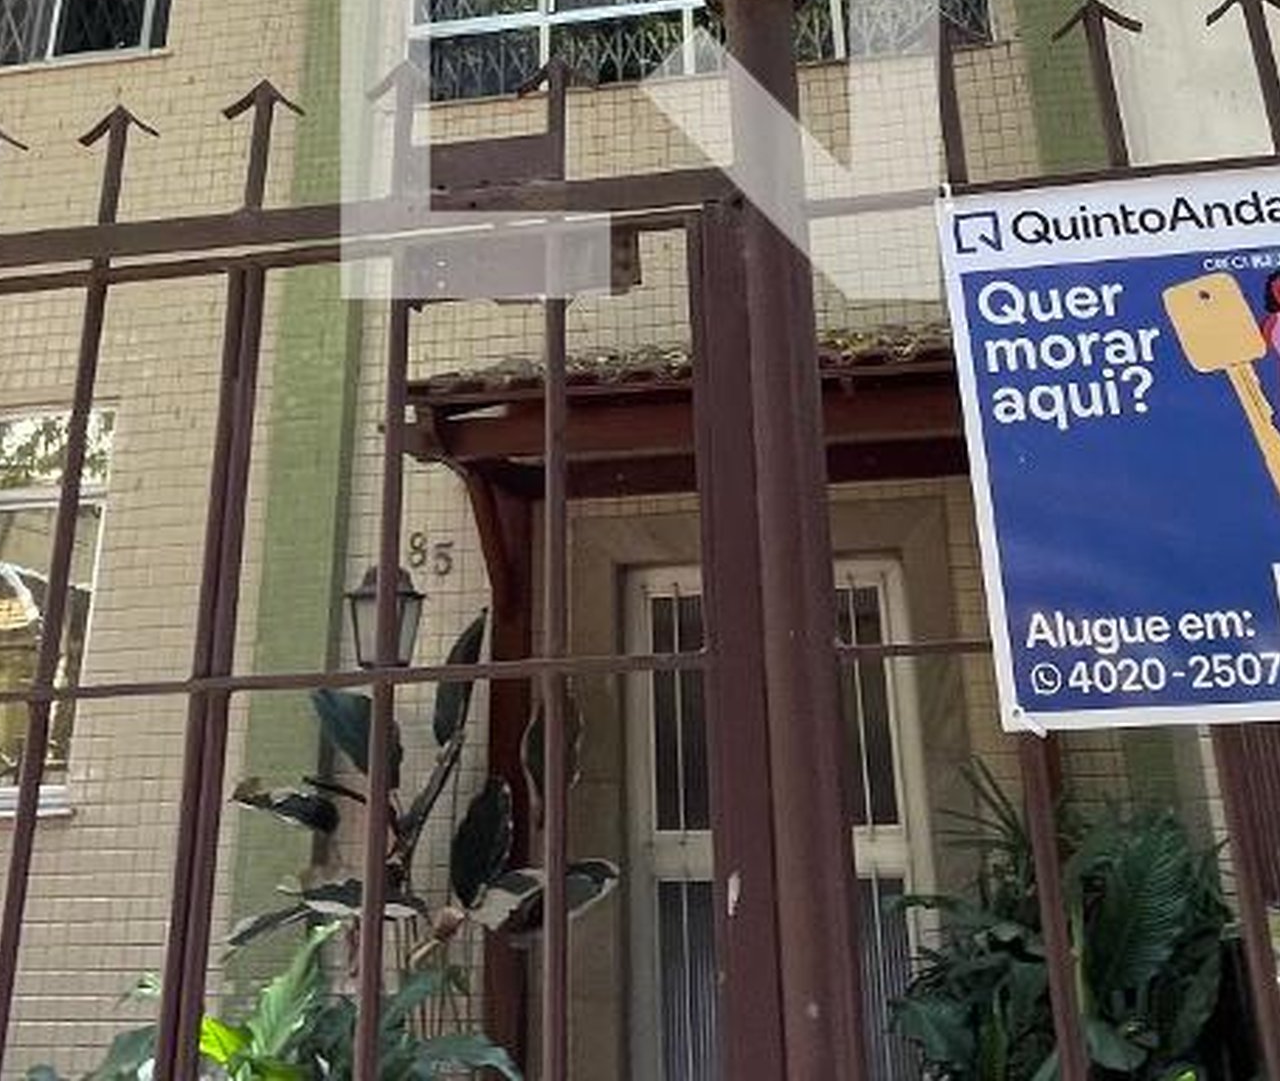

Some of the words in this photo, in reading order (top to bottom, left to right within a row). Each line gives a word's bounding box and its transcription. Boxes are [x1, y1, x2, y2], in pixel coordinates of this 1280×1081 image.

[977, 280, 1124, 325] Quer
[985, 327, 1160, 373] morar
[991, 365, 1153, 429] aqui?
[408, 531, 454, 576] 85
[1025, 612, 1171, 653] Alugue
[1179, 609, 1256, 642] em:
